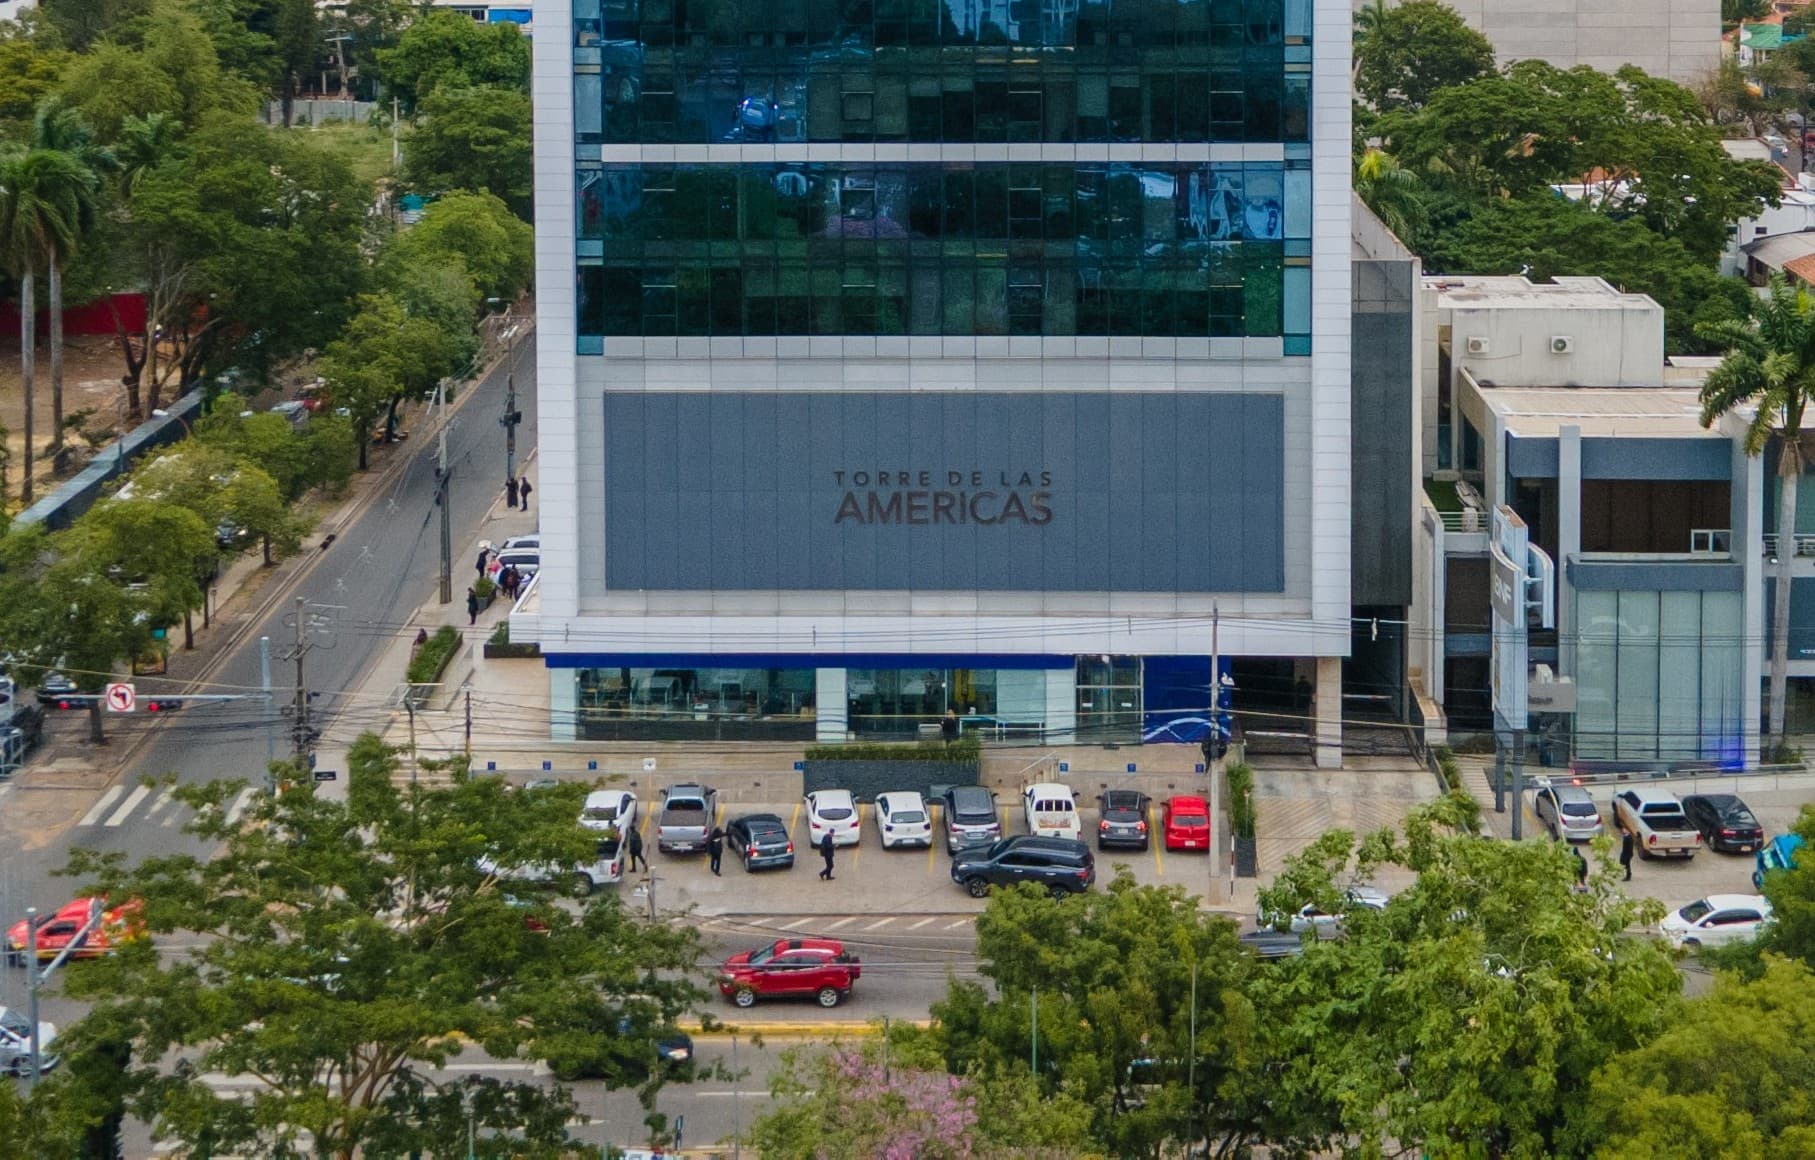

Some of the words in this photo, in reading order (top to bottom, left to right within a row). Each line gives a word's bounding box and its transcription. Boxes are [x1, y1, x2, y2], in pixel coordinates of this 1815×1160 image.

[834, 471, 930, 486] TORRE
[948, 471, 982, 486] DE
[1001, 471, 1052, 486] LAS
[834, 490, 1053, 525] AMERICAS
